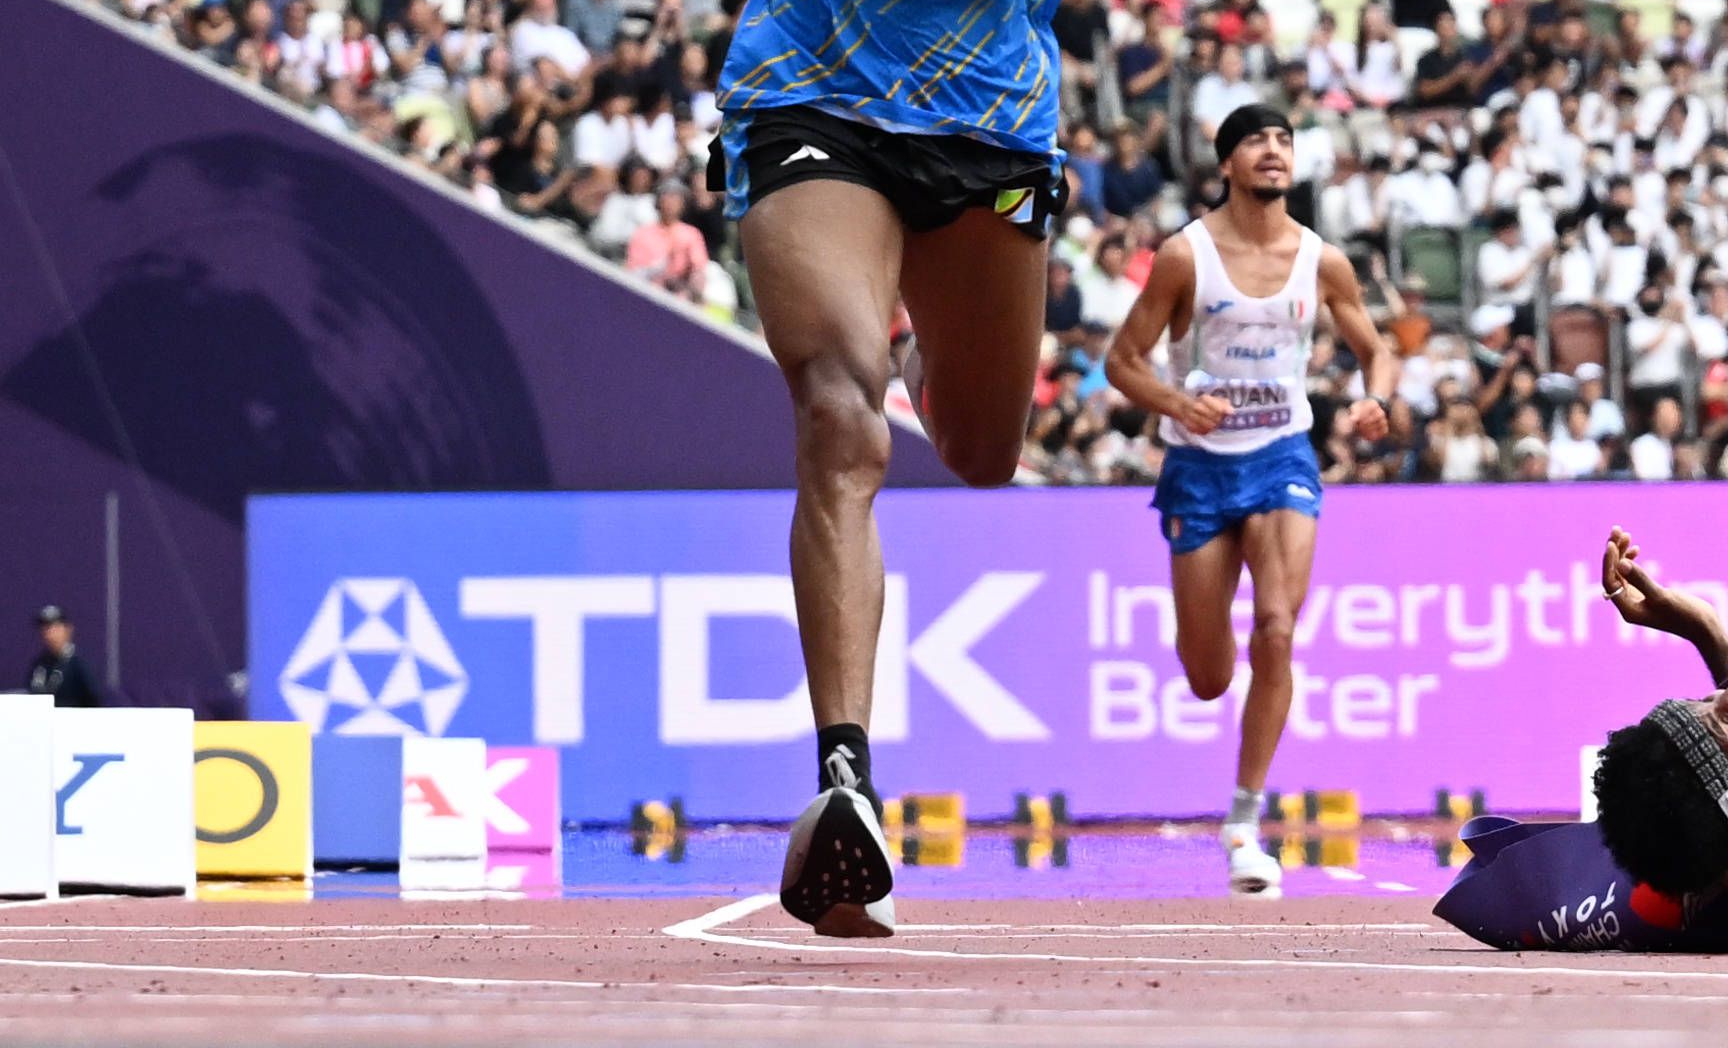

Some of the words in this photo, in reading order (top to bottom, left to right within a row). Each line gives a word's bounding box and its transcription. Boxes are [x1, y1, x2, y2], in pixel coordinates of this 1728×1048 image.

[1225, 346, 1276, 360] ITALIA
[1088, 569, 1178, 648] In
[458, 571, 1049, 745] TDK
